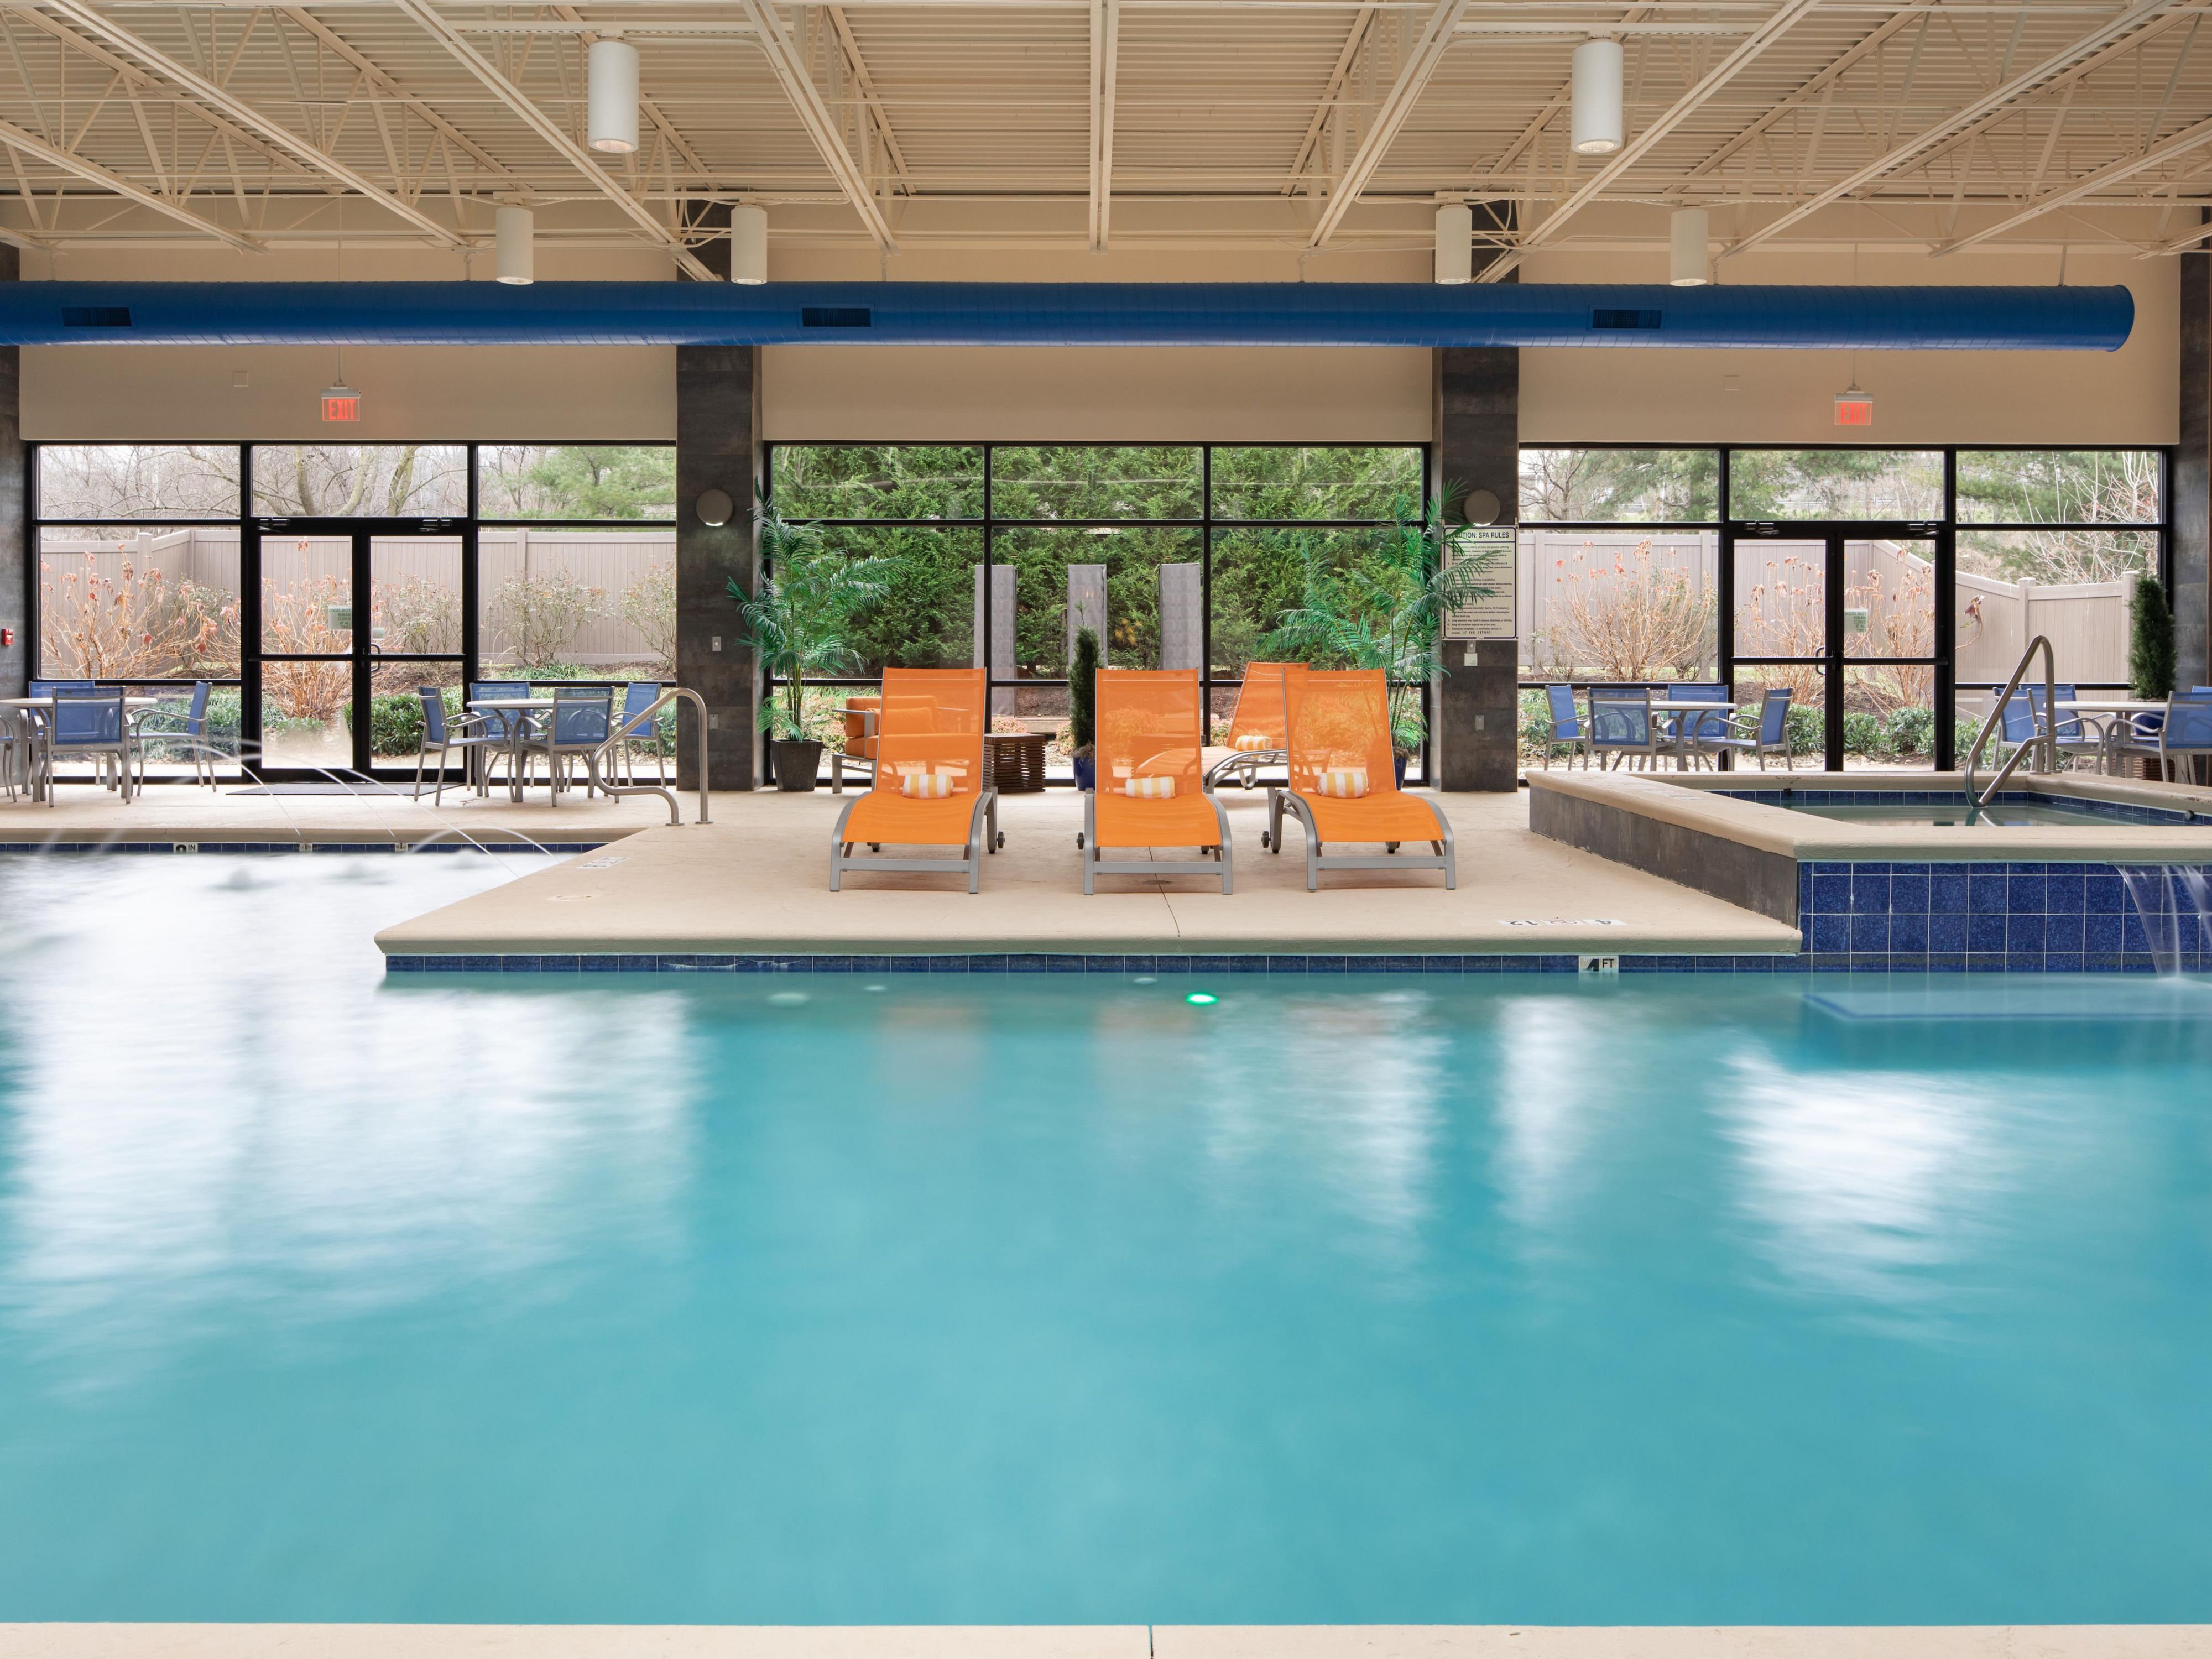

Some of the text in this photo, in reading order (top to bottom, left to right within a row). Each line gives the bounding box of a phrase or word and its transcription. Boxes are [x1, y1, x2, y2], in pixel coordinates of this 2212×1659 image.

[328, 399, 356, 420] EXIT
[1840, 403, 1867, 424] EXIT
[1602, 958, 1615, 968] FT
